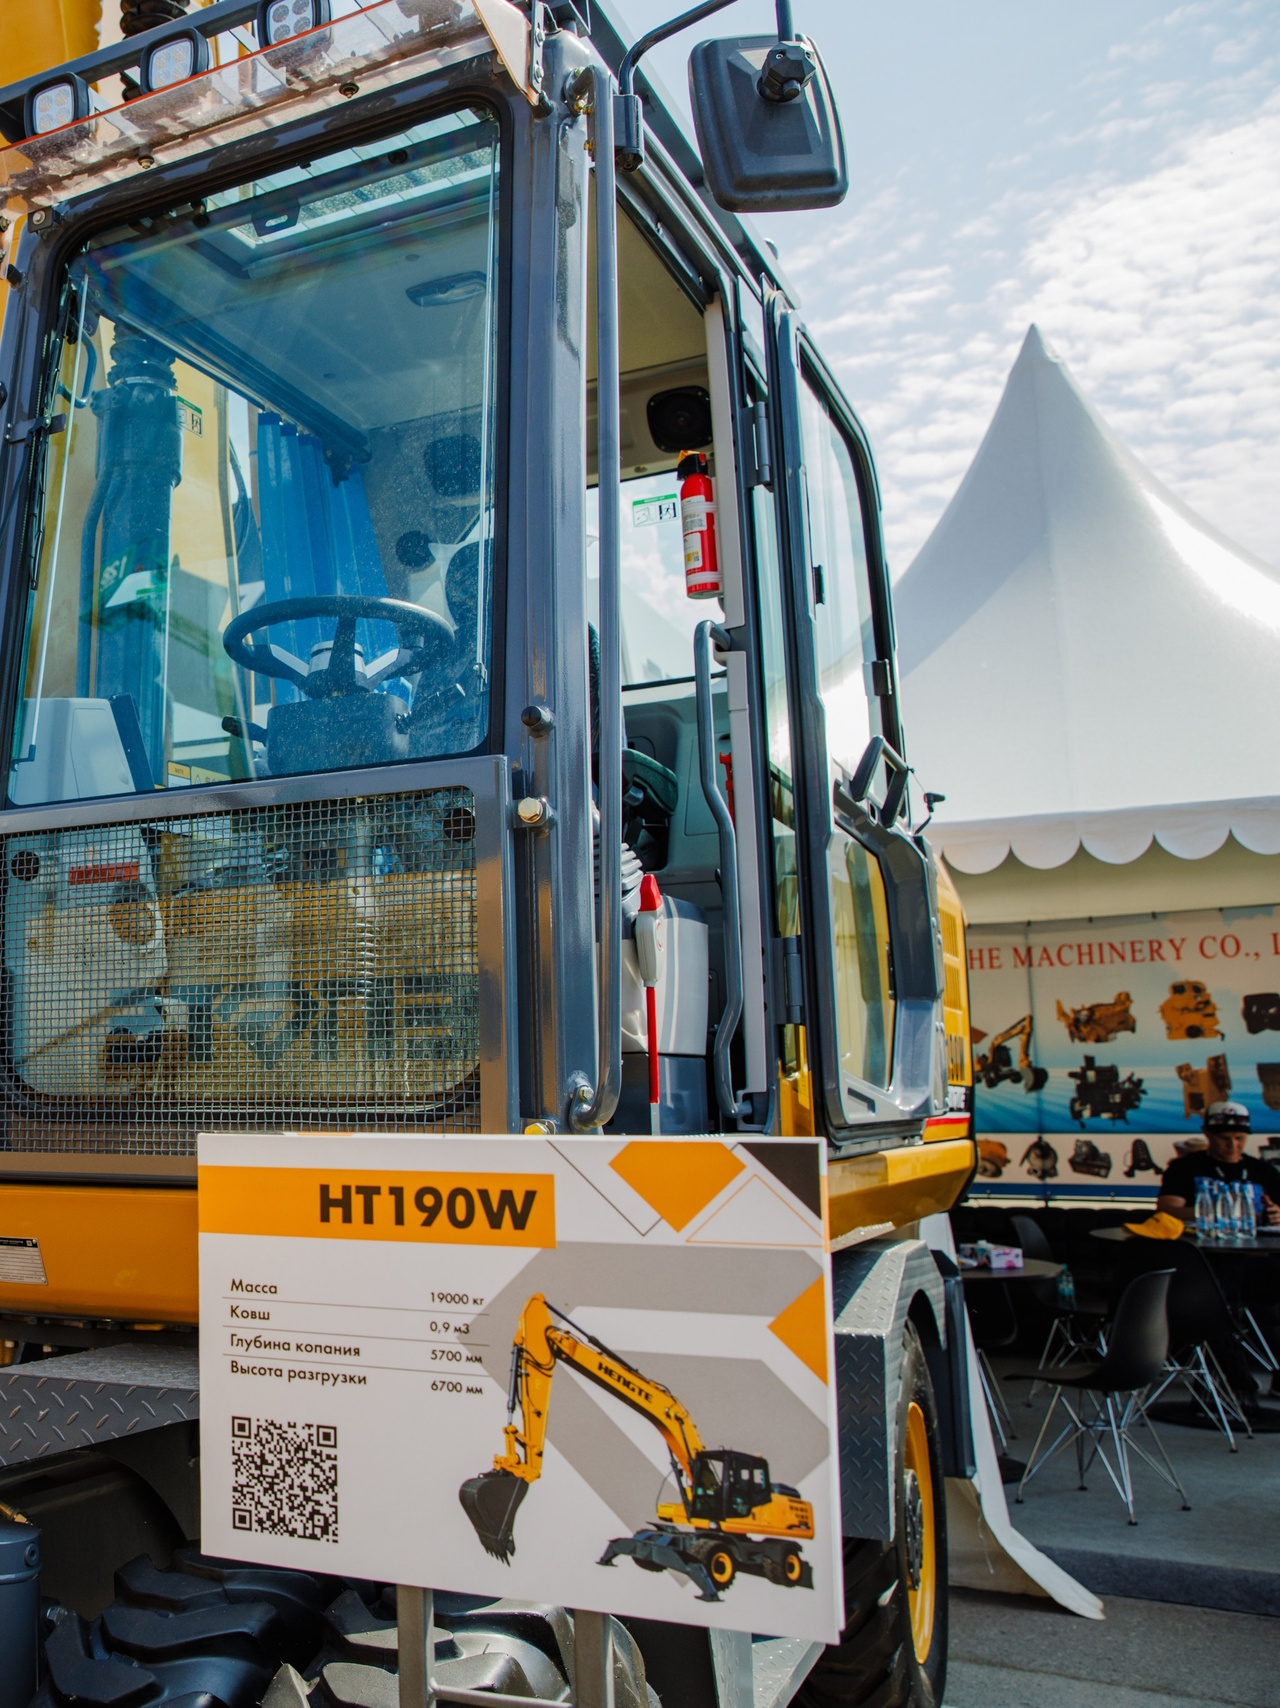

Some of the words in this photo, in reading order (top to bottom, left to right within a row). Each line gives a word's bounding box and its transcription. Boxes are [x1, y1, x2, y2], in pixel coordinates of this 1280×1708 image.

[1012, 937, 1187, 968] MACHINERY
[1198, 934, 1262, 961] CO.,
[319, 1184, 537, 1231] HT190W
[231, 1278, 278, 1294] Масса
[430, 1292, 469, 1305] 19000
[472, 1298, 485, 1306] кг
[230, 1305, 270, 1321] Ковш
[429, 1321, 450, 1334] 0,9
[453, 1323, 470, 1334] м3
[230, 1333, 291, 1352] Глубина
[295, 1342, 361, 1357] копания
[430, 1349, 462, 1362] 5700
[465, 1355, 483, 1364] мм
[230, 1360, 283, 1377] Высота
[287, 1369, 367, 1387] разгрузки
[430, 1380, 463, 1393] 6700
[465, 1386, 483, 1395] мм
[597, 1361, 653, 1404] HENGTE
